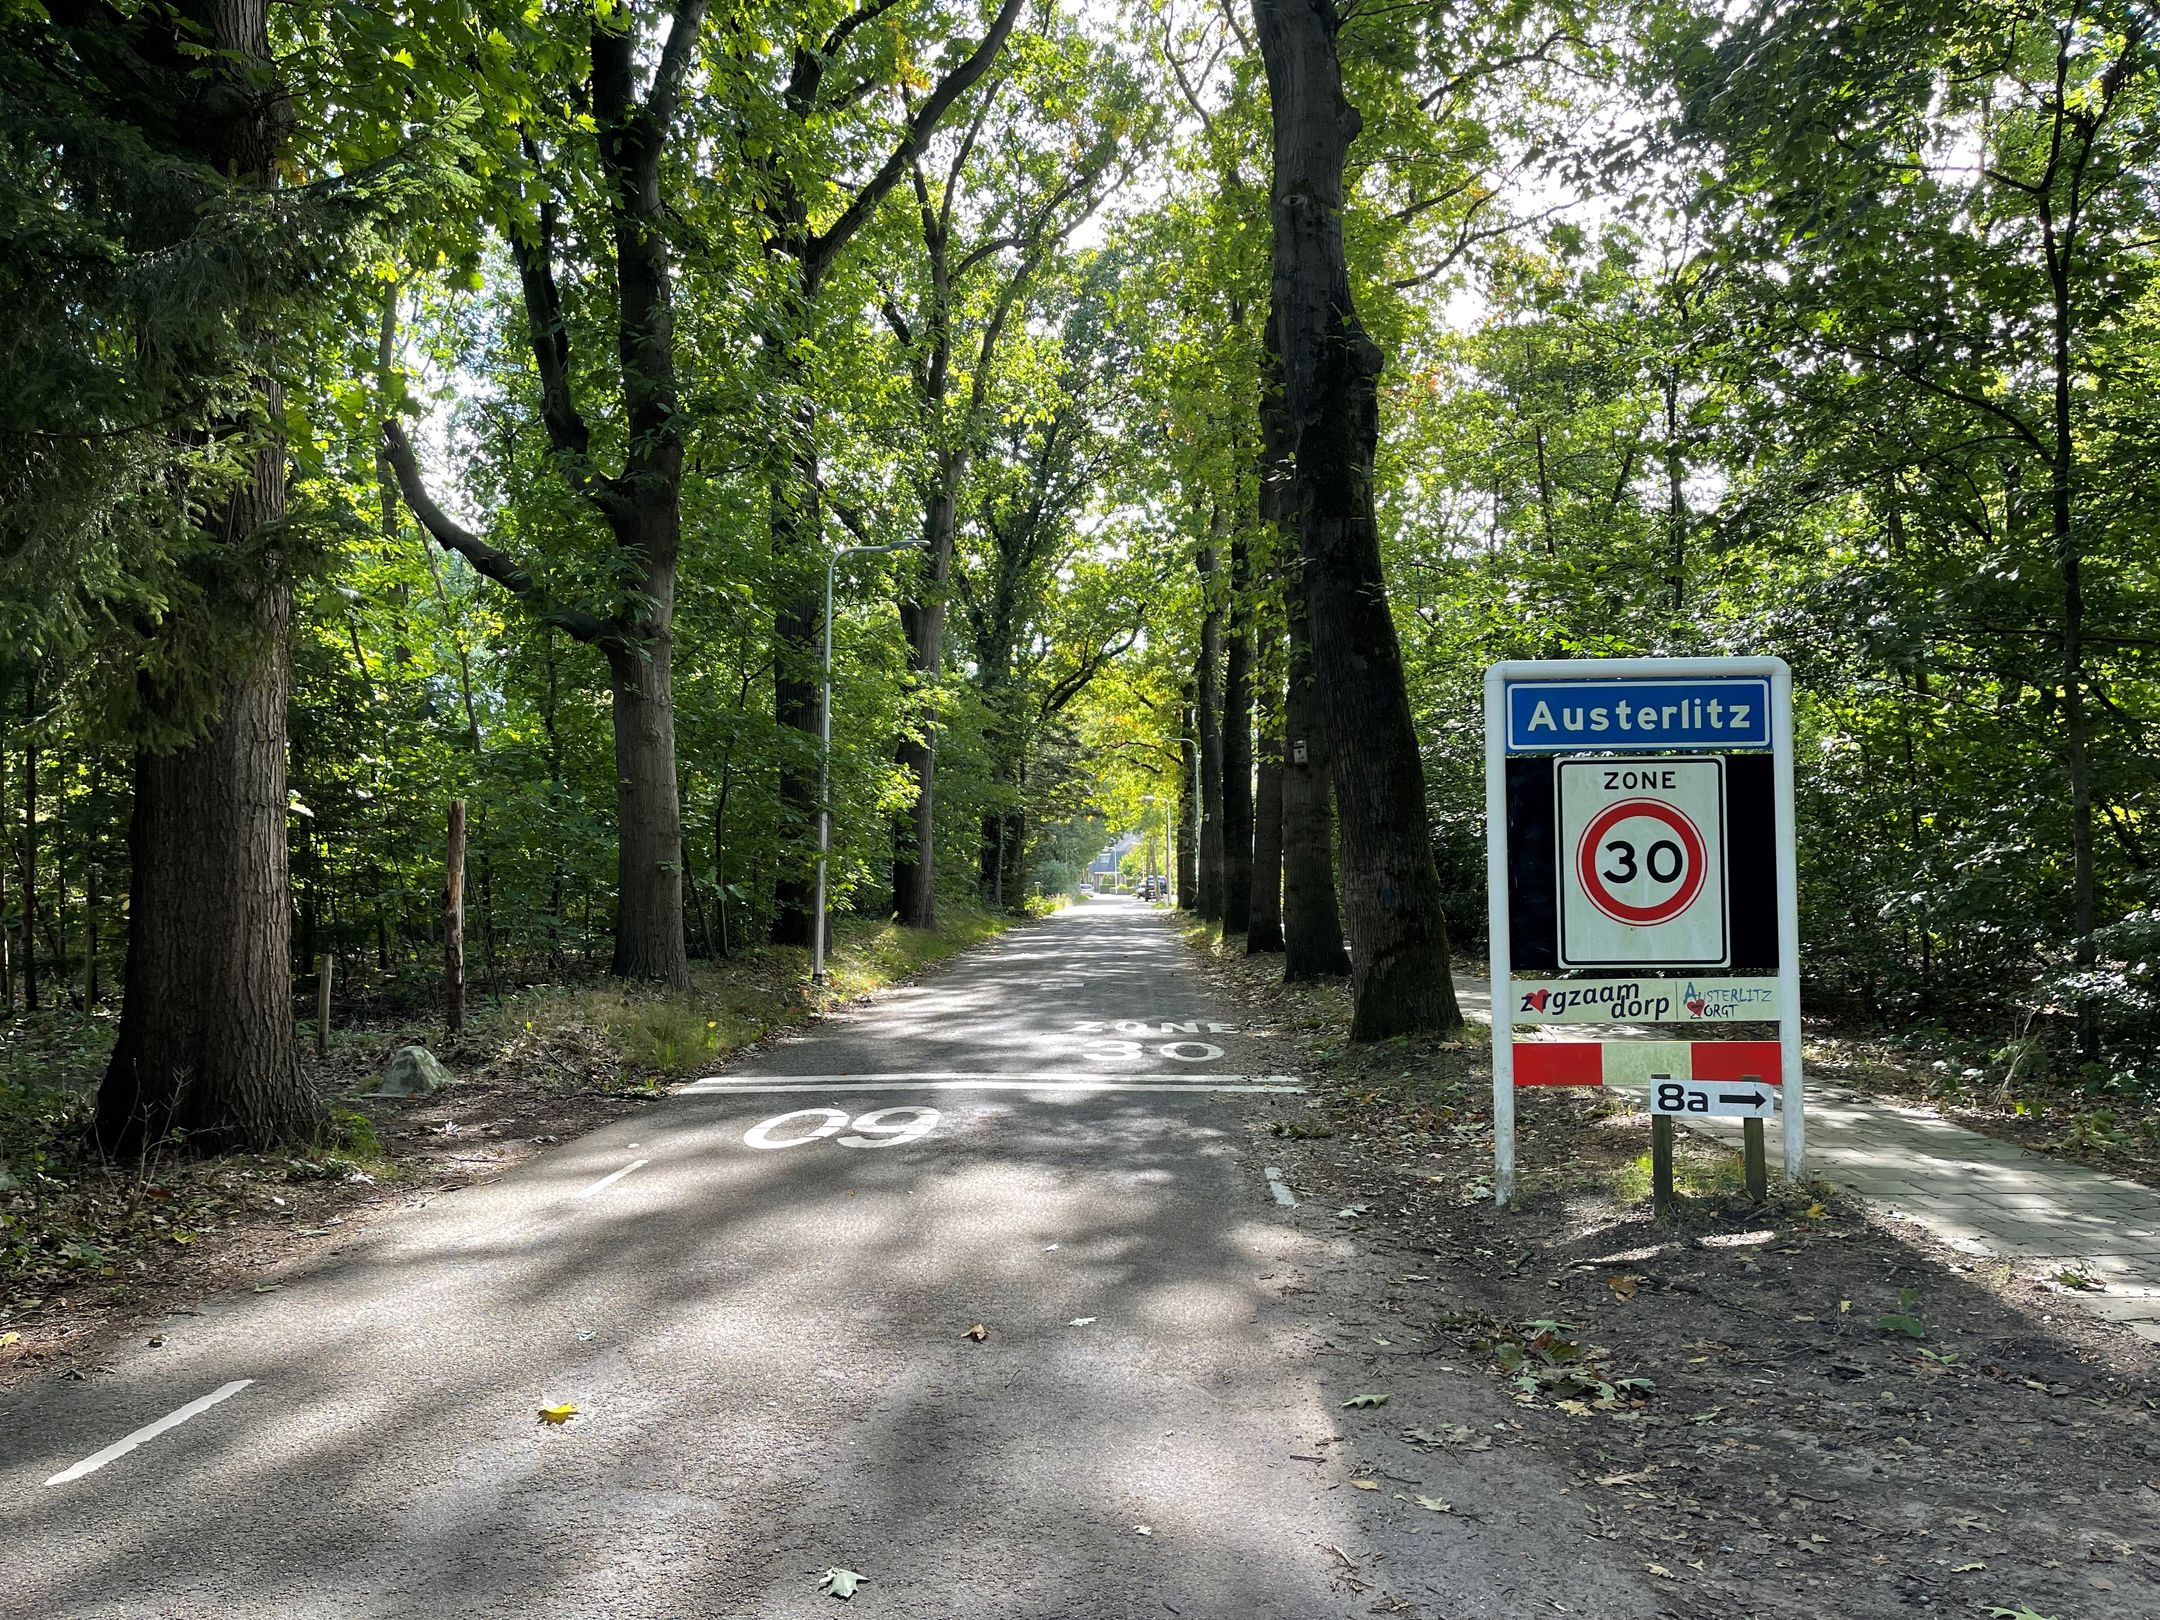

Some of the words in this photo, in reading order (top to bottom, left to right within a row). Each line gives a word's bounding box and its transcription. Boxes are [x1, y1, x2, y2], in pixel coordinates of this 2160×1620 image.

[1527, 698, 1751, 732] Austerlitz
[1603, 771, 1677, 790] ZONE
[1602, 840, 1684, 884] 30
[1611, 994, 1670, 1021] dorp
[1067, 1020, 1241, 1035] ZONE
[1082, 1040, 1226, 1062] 30
[1658, 1083, 1709, 1112] 8a
